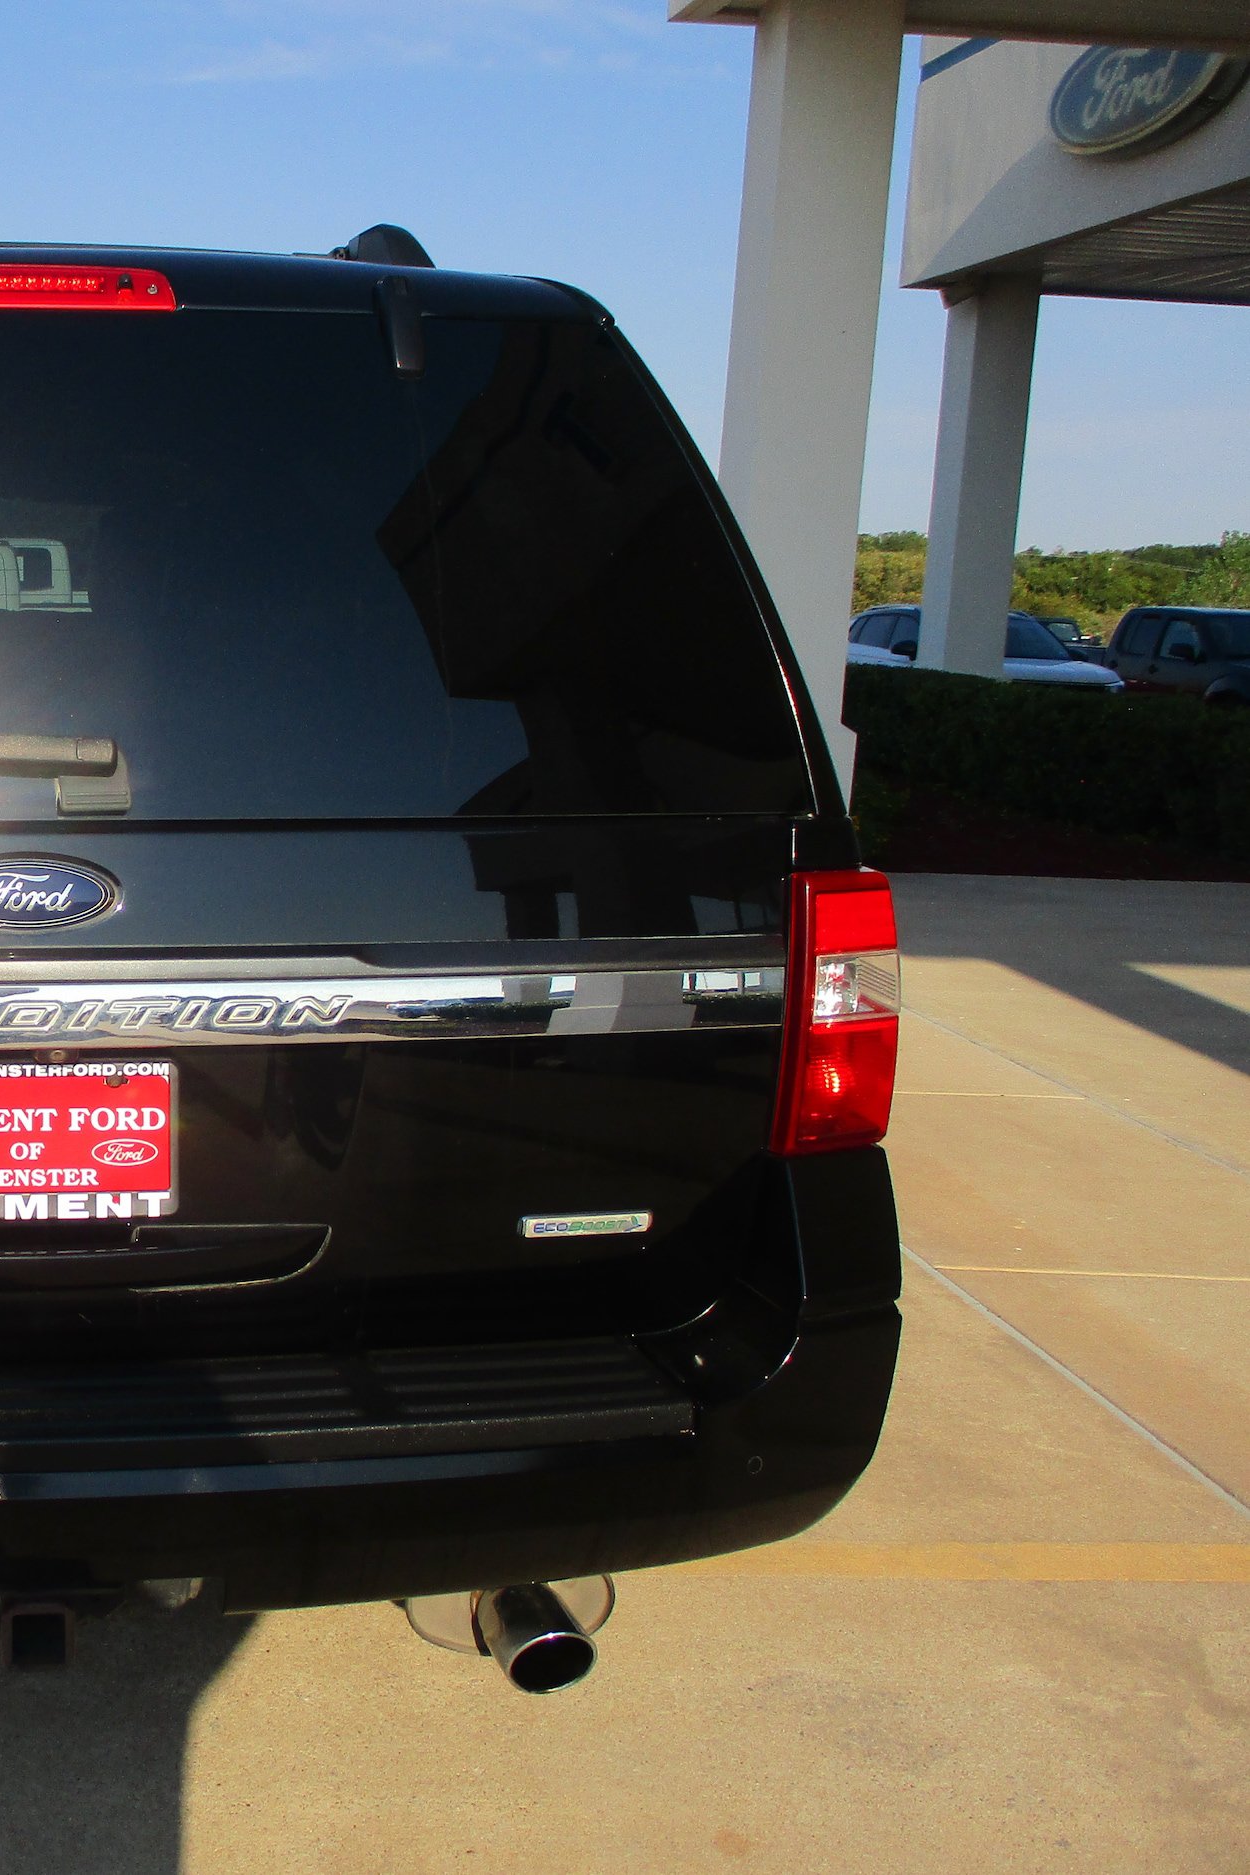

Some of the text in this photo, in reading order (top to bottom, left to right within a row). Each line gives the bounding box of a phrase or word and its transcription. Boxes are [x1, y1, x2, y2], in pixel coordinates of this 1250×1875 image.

[1082, 49, 1178, 129] Ford
[68, 1107, 166, 1131] FORD
[10, 1142, 45, 1161] OF
[103, 1143, 146, 1162] Ford
[533, 1220, 627, 1233] ECOBOOST
